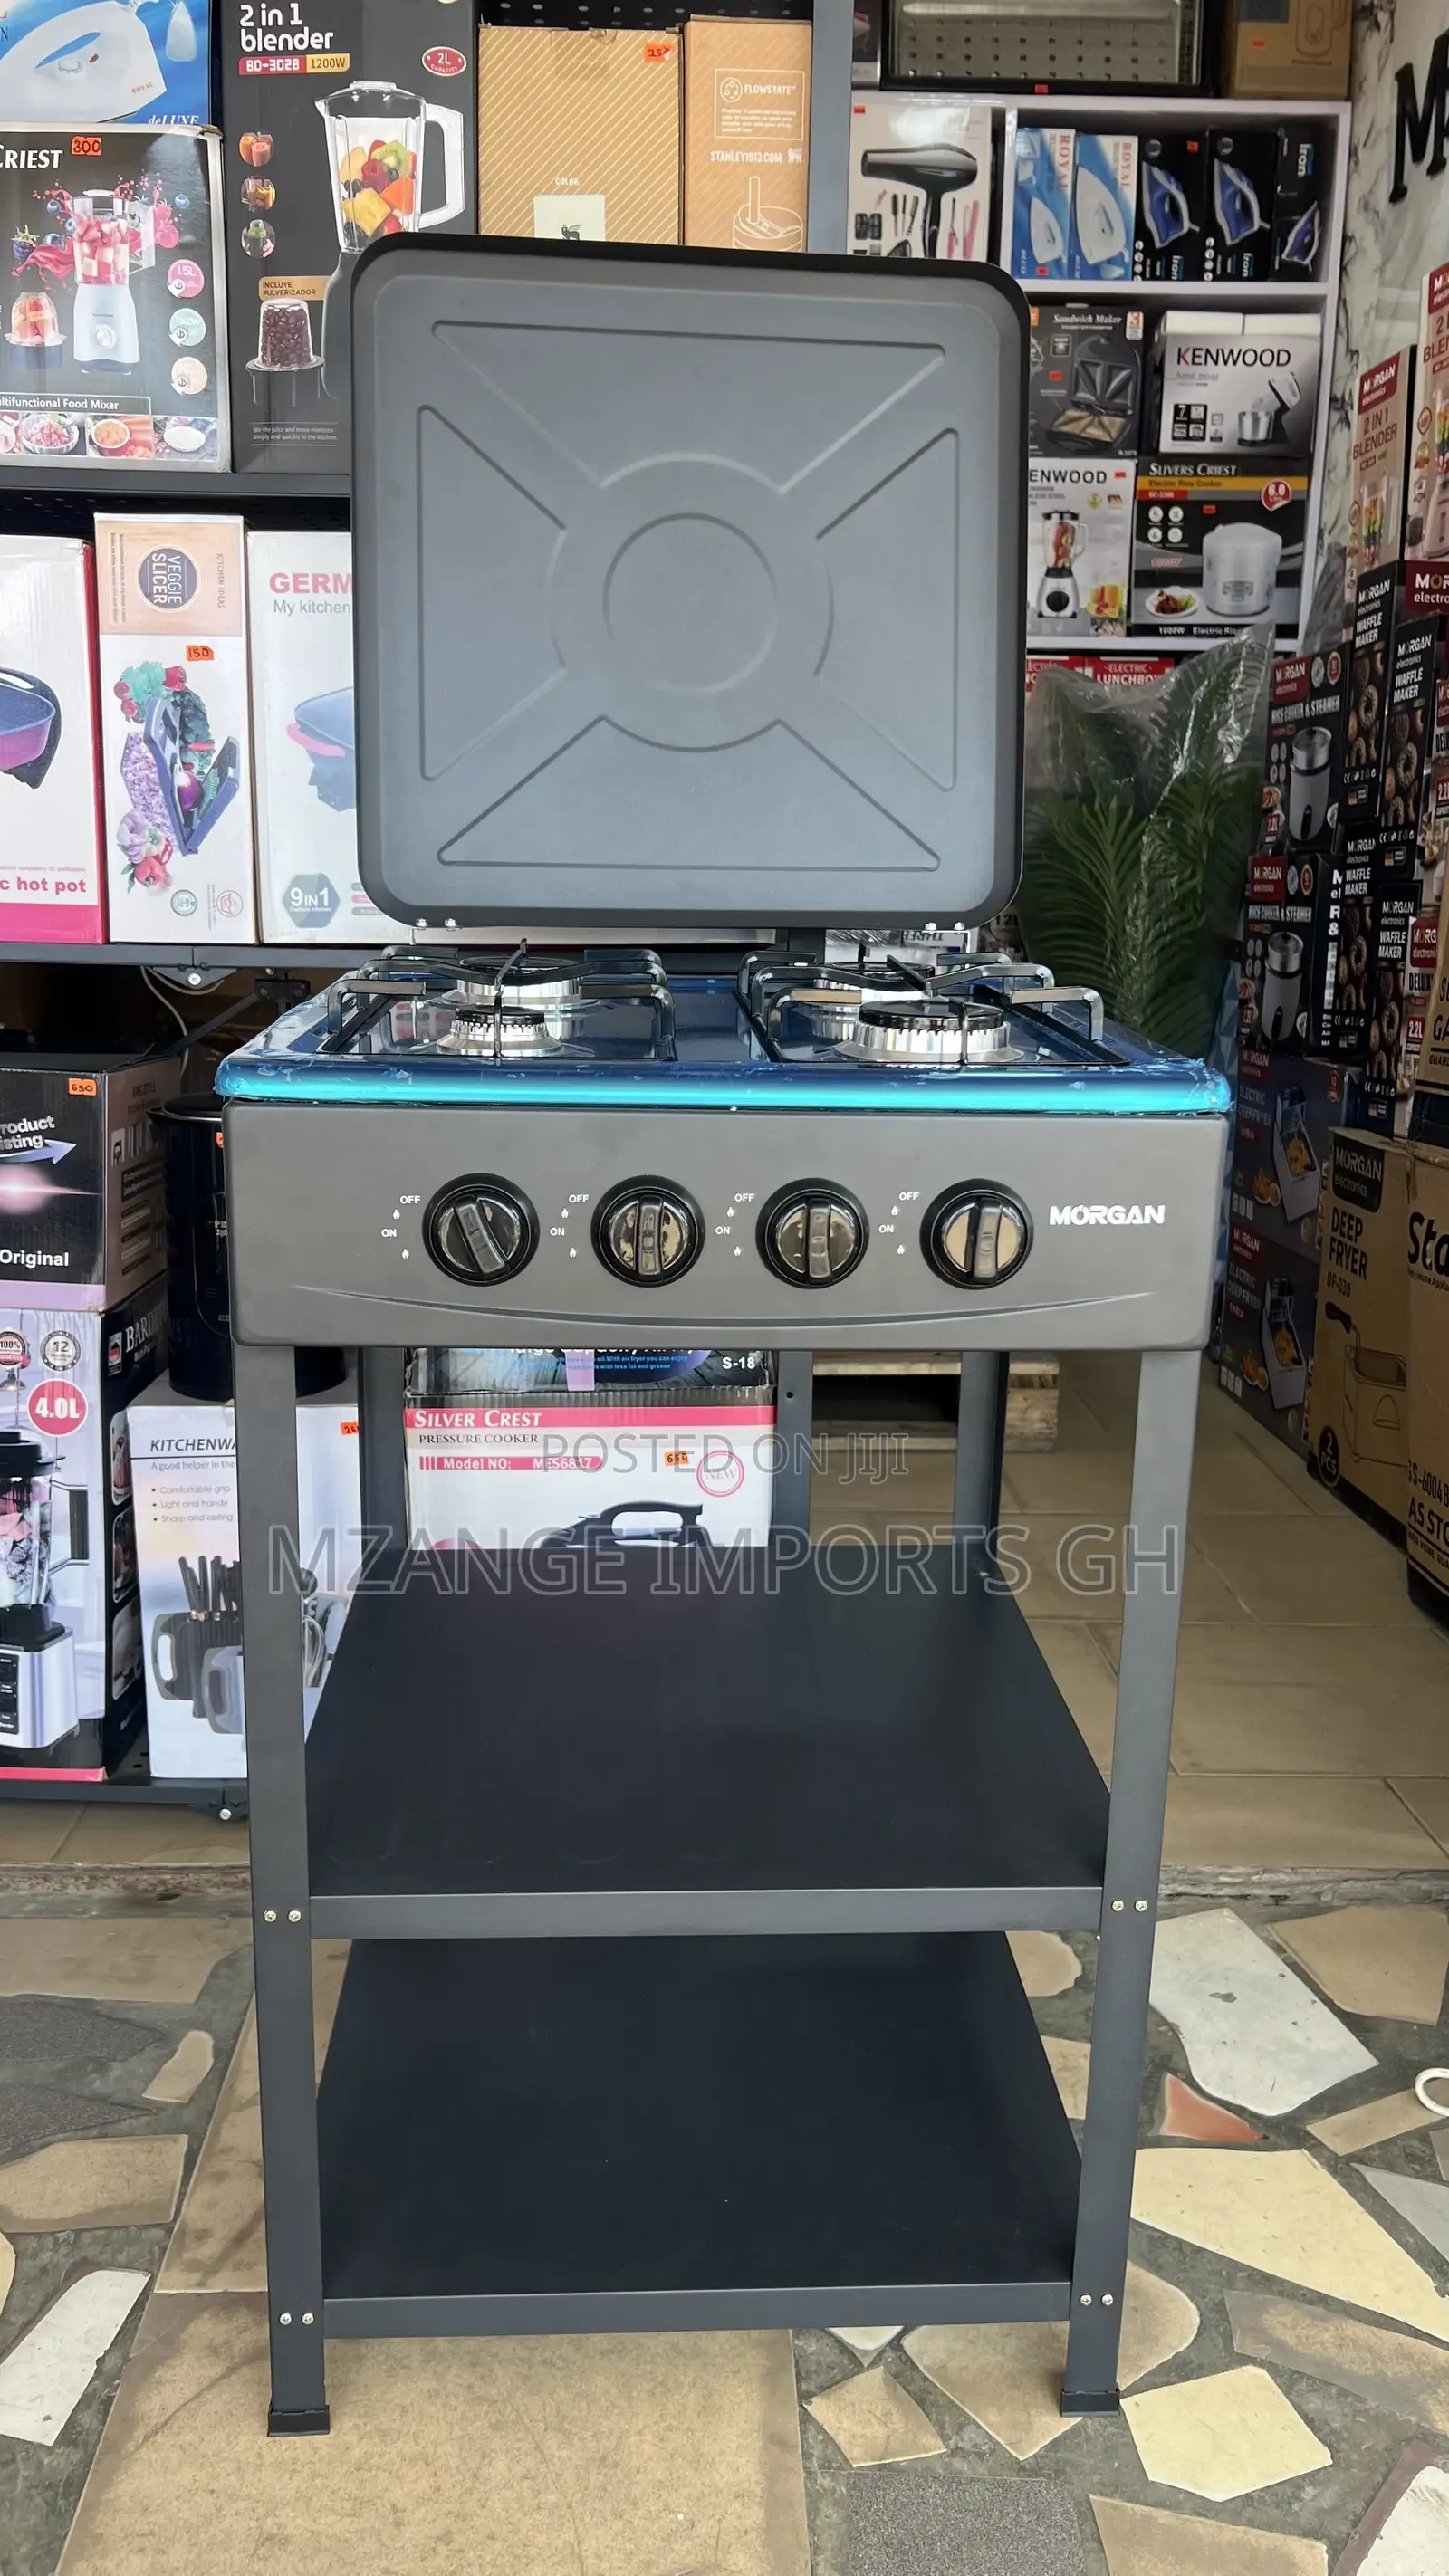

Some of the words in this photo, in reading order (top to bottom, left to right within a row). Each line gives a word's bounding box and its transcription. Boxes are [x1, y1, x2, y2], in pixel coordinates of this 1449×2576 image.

[240, 5, 254, 27] 2
[261, 4, 283, 26] in
[290, 3, 302, 25] 1
[240, 27, 333, 52] blender
[310, 59, 346, 71] 1200W
[437, 53, 451, 64] 2L
[73, 139, 101, 153] 300
[1176, 347, 1291, 367] KENWOOD
[63, 399, 87, 408] Food
[91, 399, 119, 409] Mixer
[1029, 470, 1107, 484] ENWOOD
[216, 553, 225, 585] KITCHEN
[152, 553, 168, 604] SLICER
[168, 555, 182, 604] VEGGIE
[273, 600, 294, 617] My
[299, 599, 351, 614] kitchen
[1356, 611, 1384, 634] WAFFLE
[1355, 628, 1379, 649] MAKER
[1397, 634, 1432, 657] MORGAN
[188, 646, 209, 658] 150
[1395, 667, 1424, 688] WAFFLE
[1393, 685, 1420, 704] MAKER
[1346, 867, 1371, 881] WAFFLE
[16, 876, 48, 891] hot
[54, 879, 86, 895] pot
[1345, 882, 1367, 895] MAKER
[1382, 901, 1414, 915] MORGAN
[1380, 931, 1406, 943] WAFFLE
[1413, 928, 1437, 943] MORG
[1378, 945, 1402, 959] MAKER
[1409, 973, 1434, 991] DELUX
[71, 1084, 93, 1094] 650
[0, 1115, 56, 1134] roduct
[0, 1135, 43, 1150] isting
[1335, 1145, 1382, 1183] MORGAN
[399, 1195, 421, 1204] OFF
[569, 1194, 589, 1203] OFF
[734, 1193, 754, 1202] OFF
[898, 1192, 920, 1201] OFF
[1049, 1205, 1166, 1226] MORGAN
[550, 1228, 565, 1236] ON
[715, 1226, 730, 1235] ON
[878, 1224, 894, 1233] ON
[1331, 1206, 1363, 1244] DEEP
[381, 1229, 397, 1237] ON
[0, 1249, 69, 1268] Original
[1329, 1235, 1367, 1281] FRYER
[0, 1341, 21, 1350] 100%
[53, 1341, 69, 1353] 12
[722, 1357, 755, 1370] S-18
[35, 1397, 80, 1419] 4.0L
[414, 1410, 475, 1427] SILVER
[485, 1410, 542, 1427] CREST
[419, 1434, 482, 1444] PRESSURE
[485, 1433, 539, 1443] COOKER
[444, 1457, 484, 1469] Model
[487, 1457, 512, 1469] NO:
[667, 1452, 688, 1463] 650
[150, 1462, 158, 1470] A
[159, 1461, 180, 1471] good
[183, 1460, 208, 1470] helper
[222, 1460, 235, 1468] the
[706, 1469, 737, 1480] NEW
[160, 1486, 212, 1494] Comfortable
[161, 1500, 180, 1509] Light
[202, 1499, 227, 1508] handy
[161, 1515, 186, 1523] Sharp
[207, 1514, 233, 1523] lasting
